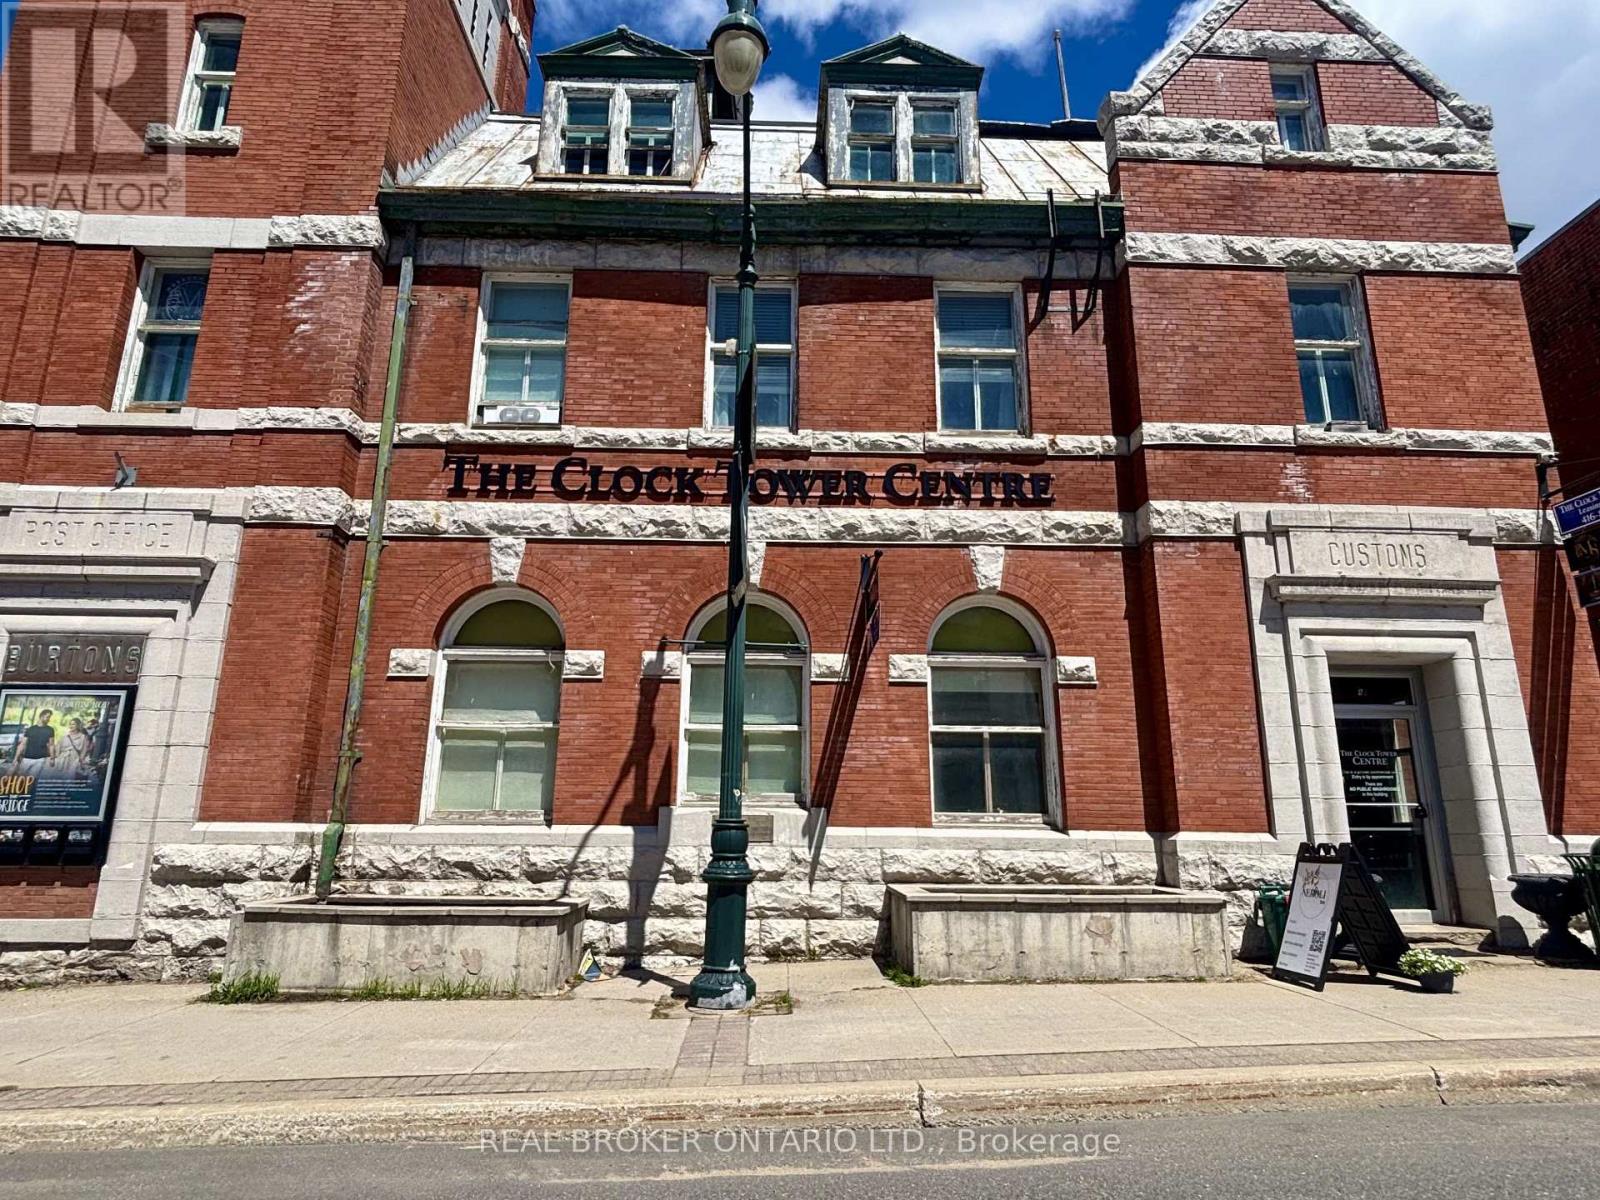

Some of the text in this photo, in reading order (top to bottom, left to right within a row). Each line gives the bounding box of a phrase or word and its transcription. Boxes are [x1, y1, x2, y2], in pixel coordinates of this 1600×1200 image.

[443, 455, 537, 498] THE
[551, 457, 707, 500] CLOCK
[882, 463, 1053, 505] CENTRE
[23, 519, 173, 548] POST OFFICE
[1328, 541, 1427, 568] CUSTOMS
[6, 644, 141, 674] BURTONS
[1352, 756, 1389, 766] CENTRE
[1354, 749, 1375, 757] CLOCK
